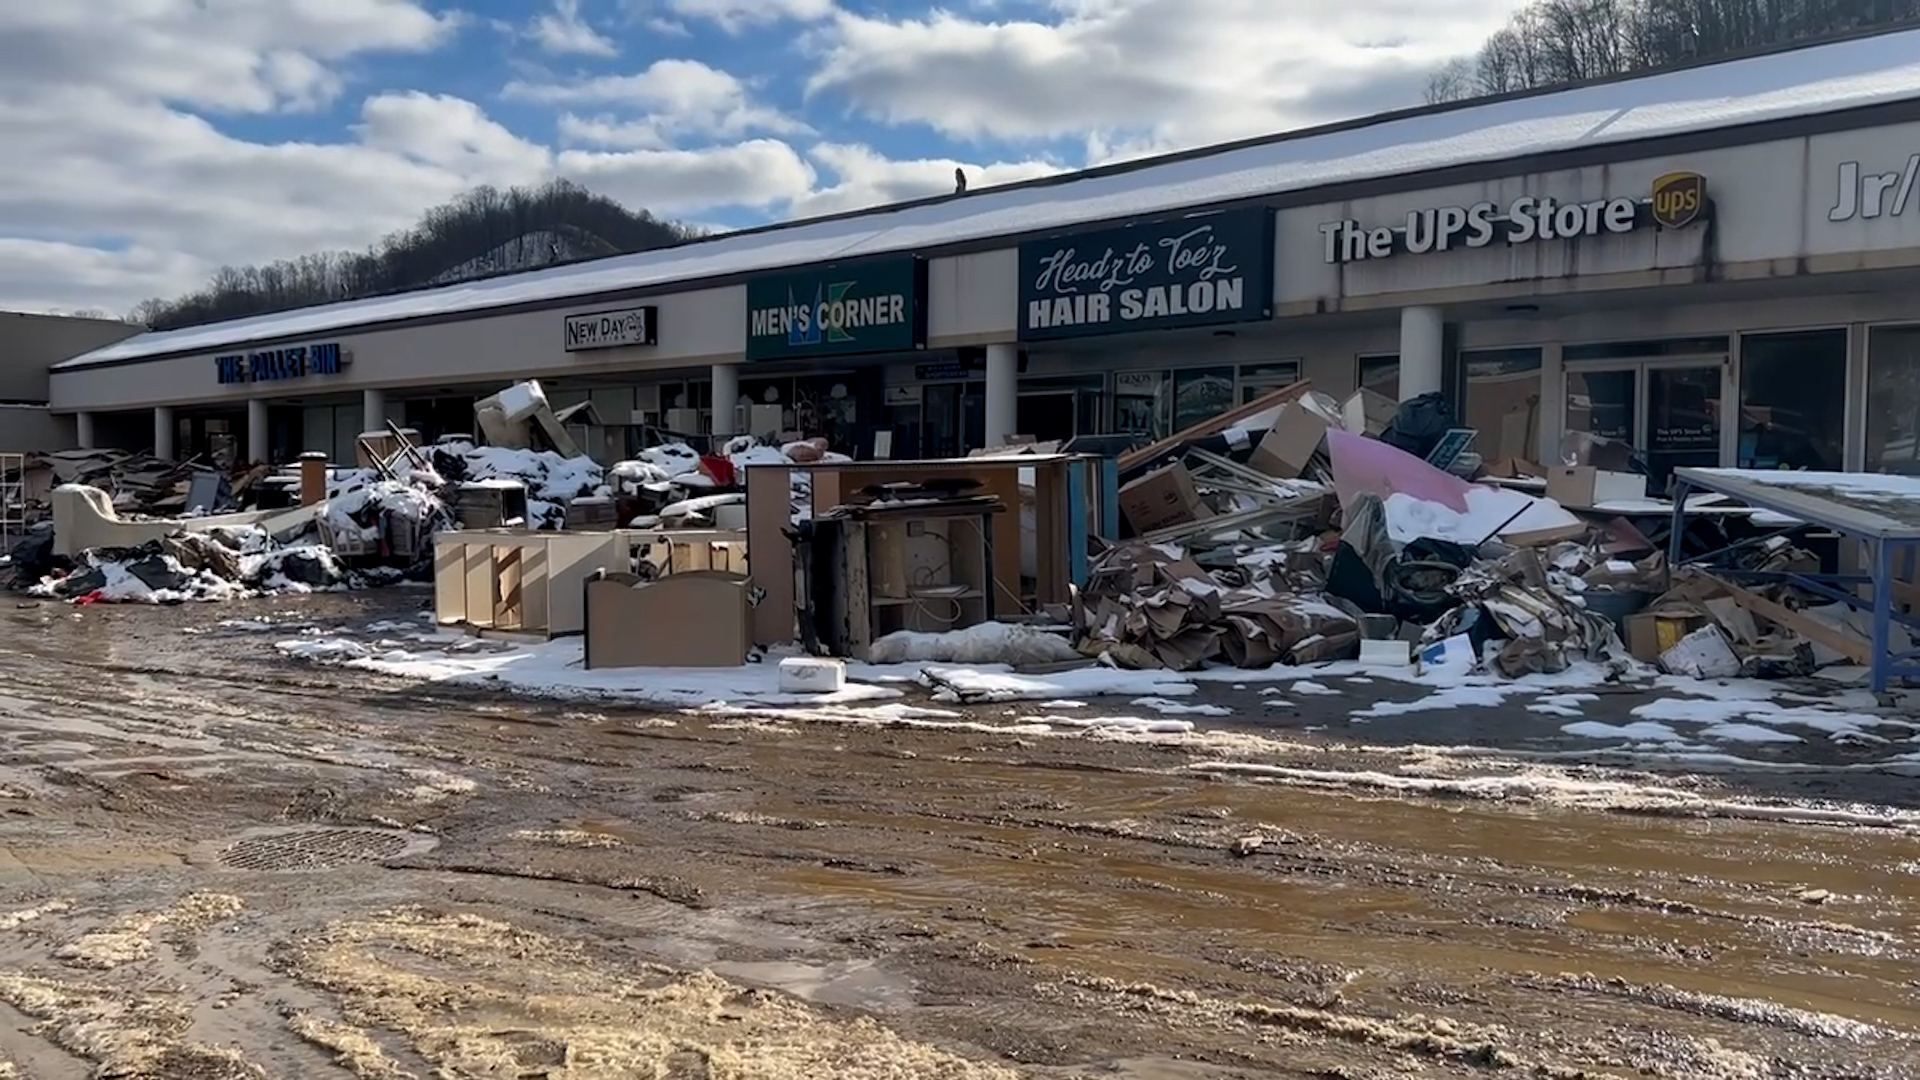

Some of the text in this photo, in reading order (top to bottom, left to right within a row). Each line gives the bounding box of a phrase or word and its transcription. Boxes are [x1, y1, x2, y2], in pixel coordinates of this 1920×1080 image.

[1656, 189, 1697, 220] ups
[1829, 154, 1920, 221] Jr/
[1318, 196, 1636, 264] The UPS Store
[1124, 243, 1155, 274] to
[751, 294, 906, 337] MEN'S CORNER
[1028, 277, 1244, 330] HAIR SALON
[568, 317, 626, 345] NEW DAY
[215, 343, 340, 384] THE PALLET BIN
